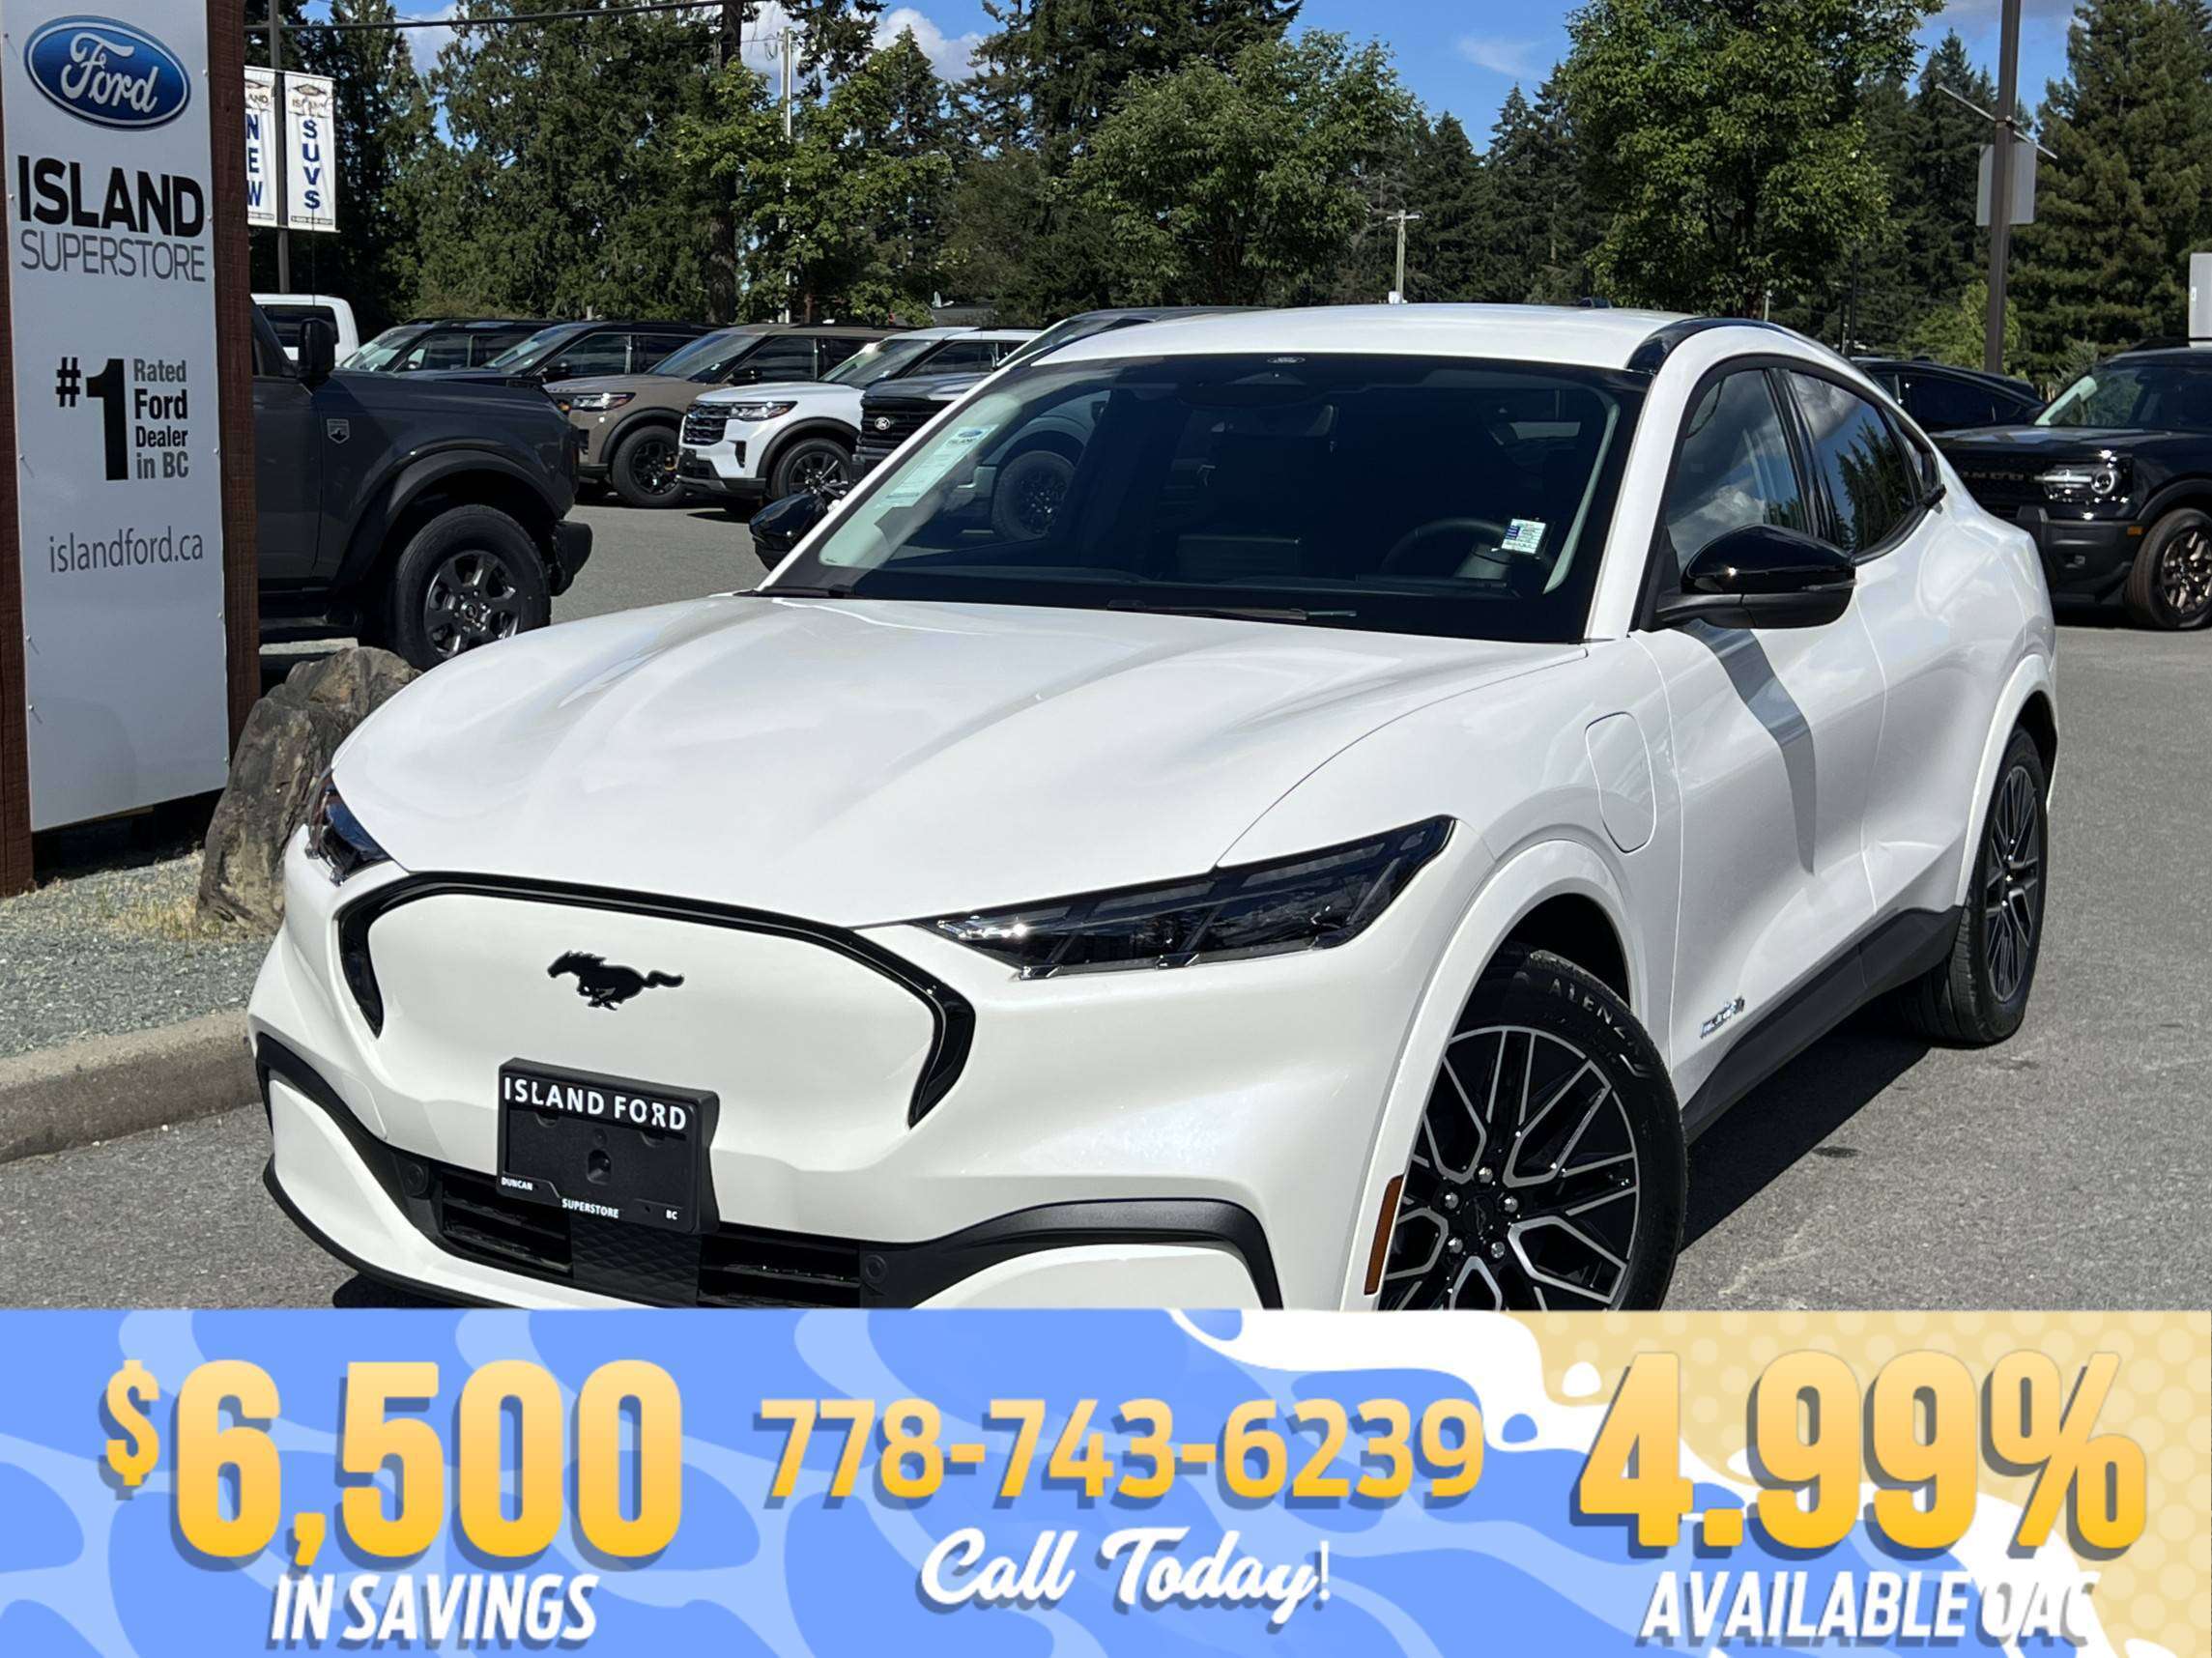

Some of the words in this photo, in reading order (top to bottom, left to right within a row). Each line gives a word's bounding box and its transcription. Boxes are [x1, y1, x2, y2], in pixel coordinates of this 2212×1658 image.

[60, 32, 159, 114] Ford
[302, 119, 322, 210] SUVS
[17, 155, 205, 238] ISLAND
[20, 228, 206, 283] SUPERSTORE
[133, 358, 187, 383] Rated
[134, 388, 188, 420] Ford
[135, 425, 189, 448] Dealer
[136, 452, 156, 480] in
[162, 450, 189, 479] BC
[48, 526, 204, 573] islandford.ca
[503, 1076, 605, 1116] ISLAND
[613, 1094, 687, 1130] FORD
[500, 1176, 533, 1191] DUNCAN
[560, 1197, 620, 1219] SUPERSTORE
[665, 1209, 678, 1221] BC
